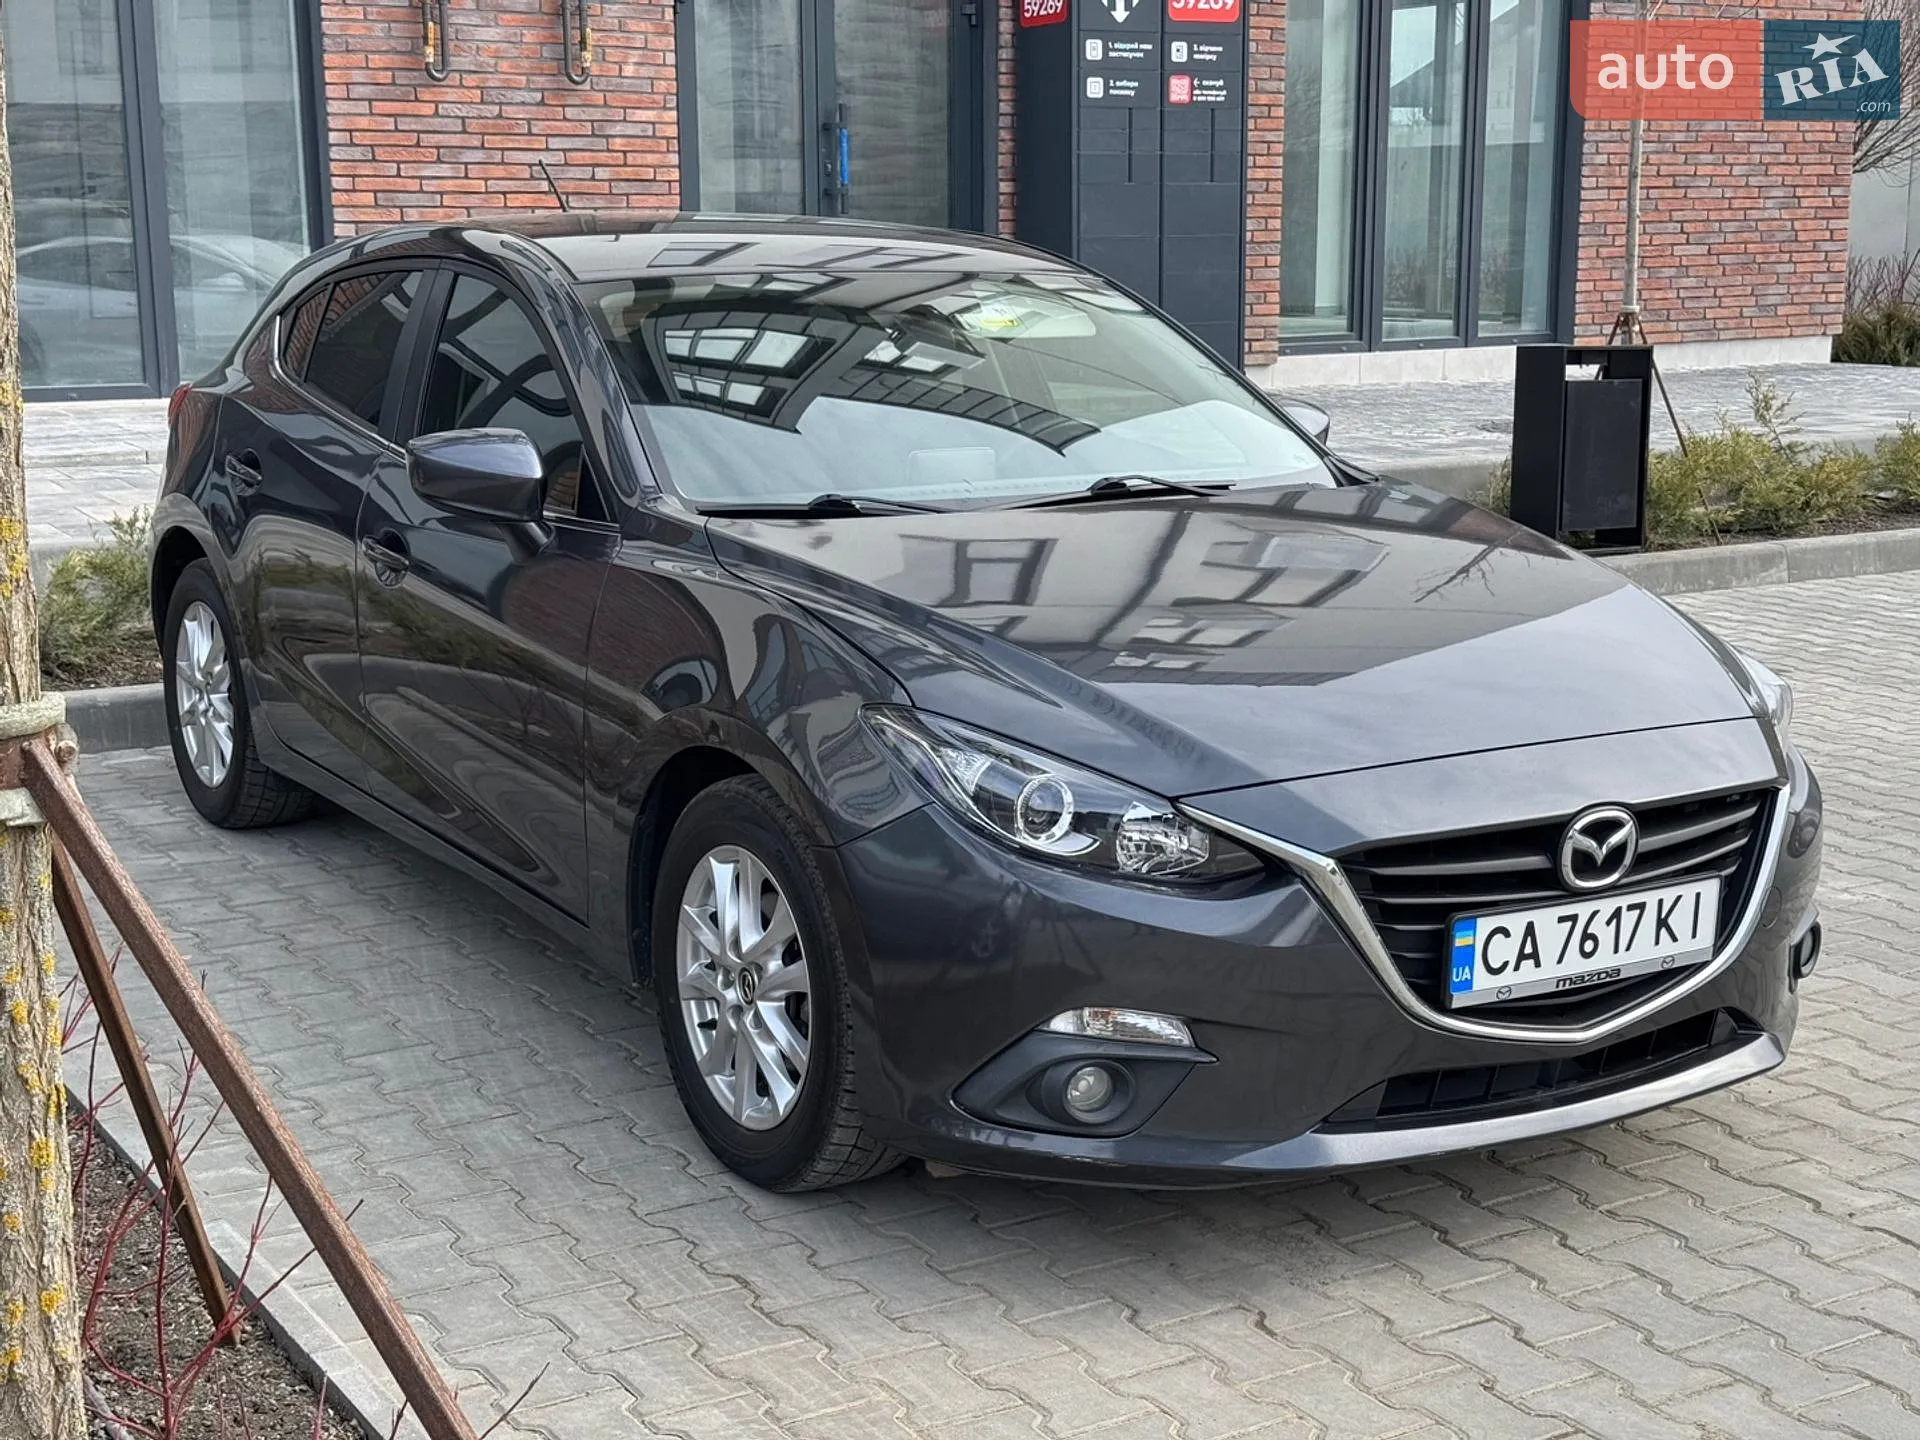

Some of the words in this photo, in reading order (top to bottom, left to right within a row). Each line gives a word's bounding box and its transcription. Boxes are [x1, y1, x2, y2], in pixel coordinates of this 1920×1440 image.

[1023, 0, 1063, 18] 59269
[1481, 920, 1542, 977] CA
[1556, 900, 1647, 966] 7617
[1654, 891, 1702, 947] KI
[1452, 966, 1471, 983] UA
